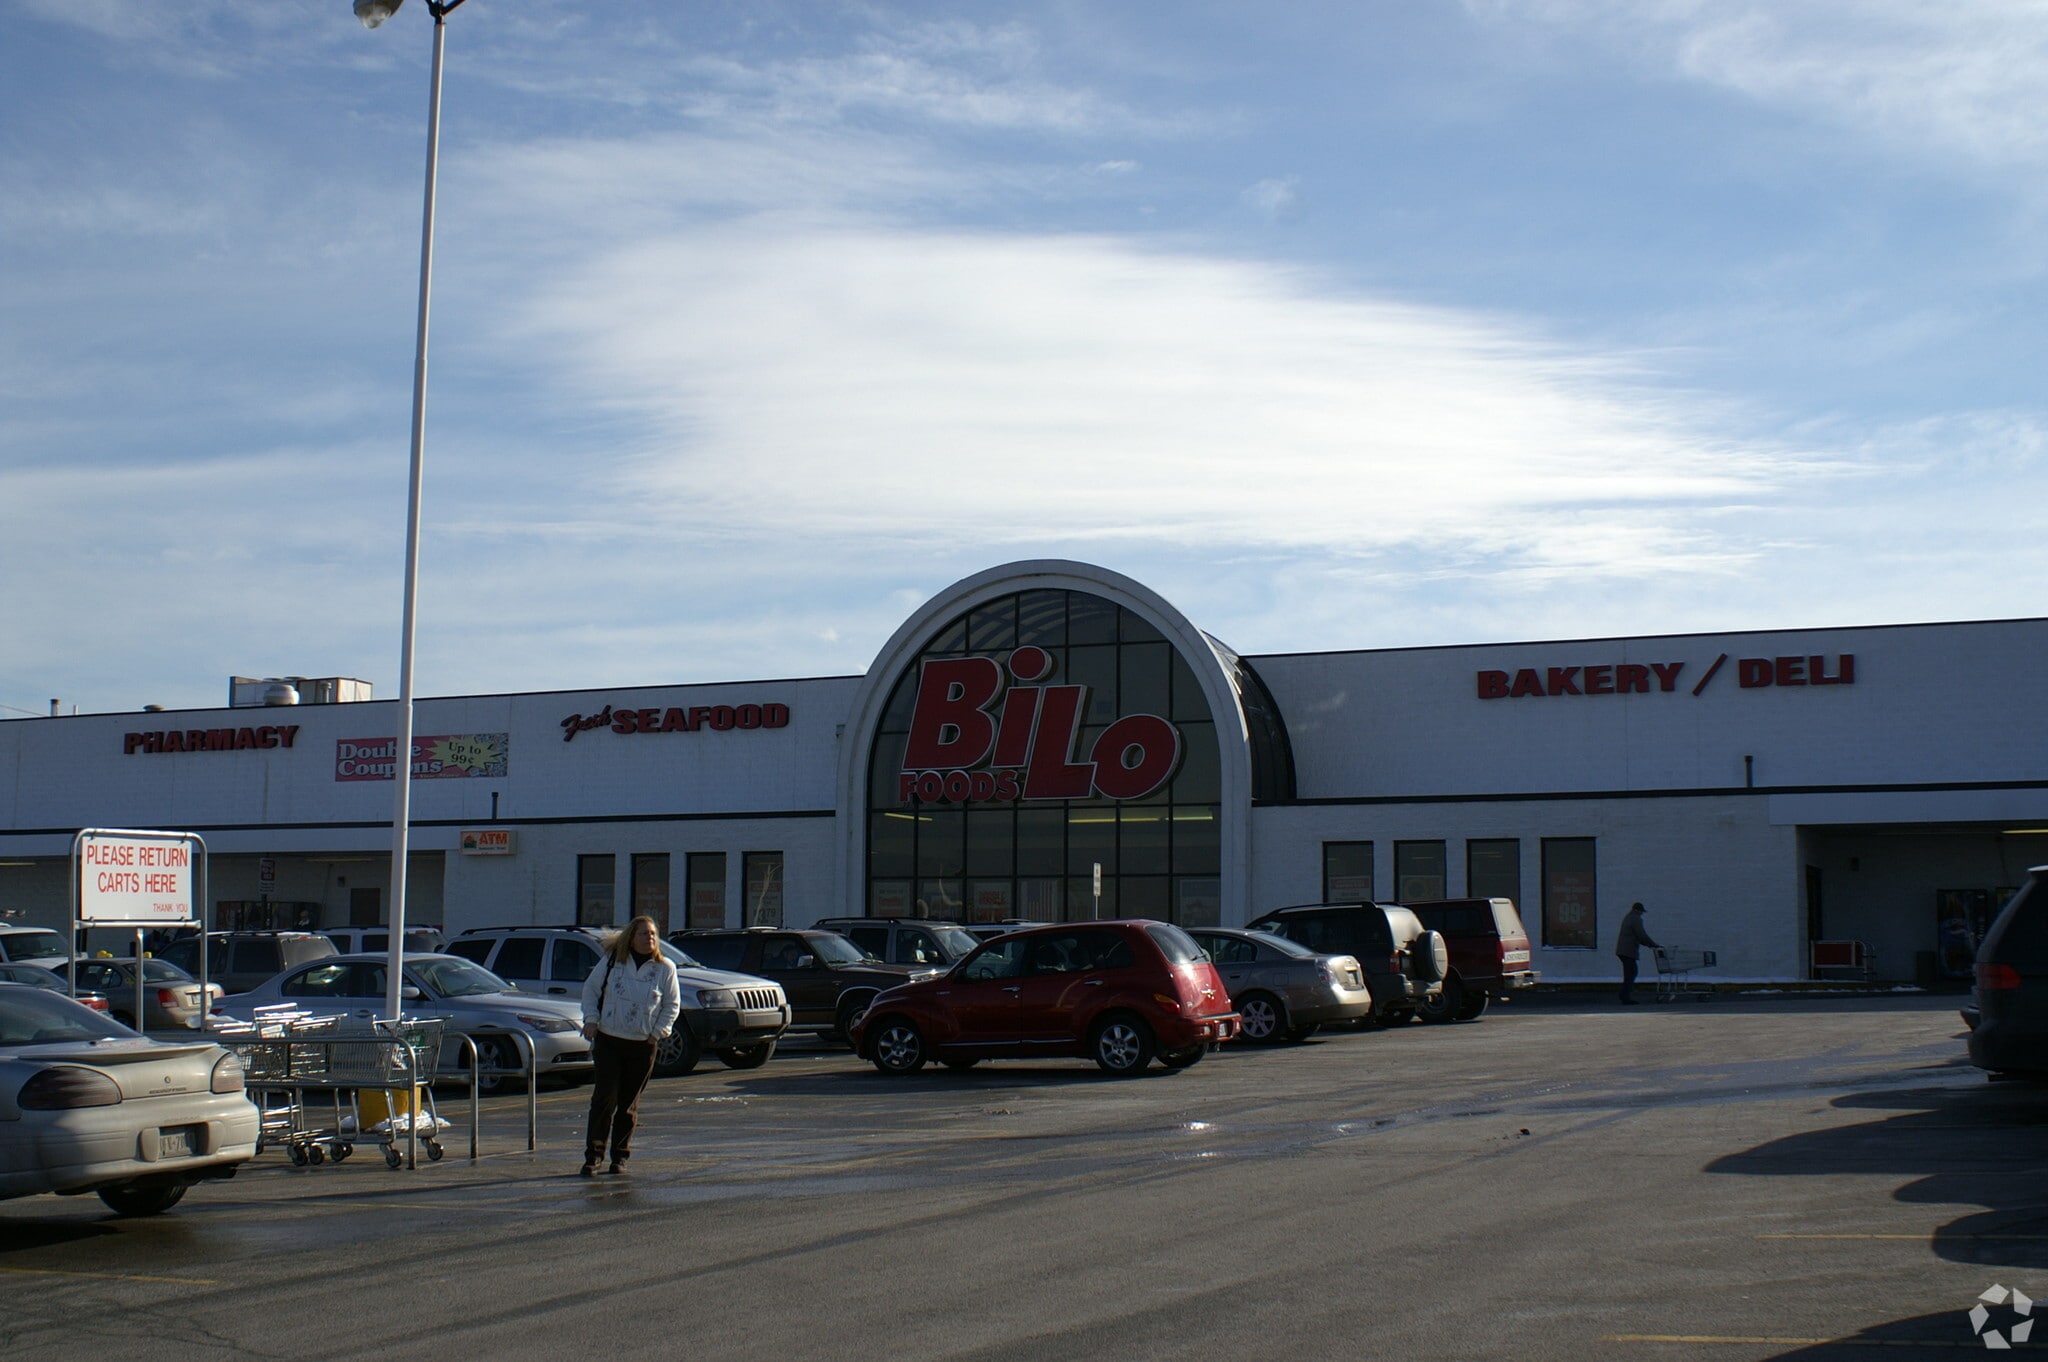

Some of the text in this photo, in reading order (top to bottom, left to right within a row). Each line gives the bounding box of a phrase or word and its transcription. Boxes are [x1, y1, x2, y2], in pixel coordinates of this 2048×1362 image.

[1477, 661, 1685, 699] BAKERY
[1739, 653, 1855, 689] DELI
[611, 703, 790, 734] SEAFOOD
[123, 725, 299, 754] PHARMACY
[448, 741, 482, 755] Up to
[338, 741, 422, 760] Doube
[337, 760, 443, 778] Coupns
[899, 770, 1021, 801] FOODS
[479, 832, 508, 845] ATM
[86, 845, 188, 867] PLEASE RETURN
[97, 872, 177, 893] CARTS HERE
[153, 903, 188, 913] THANK YOU
